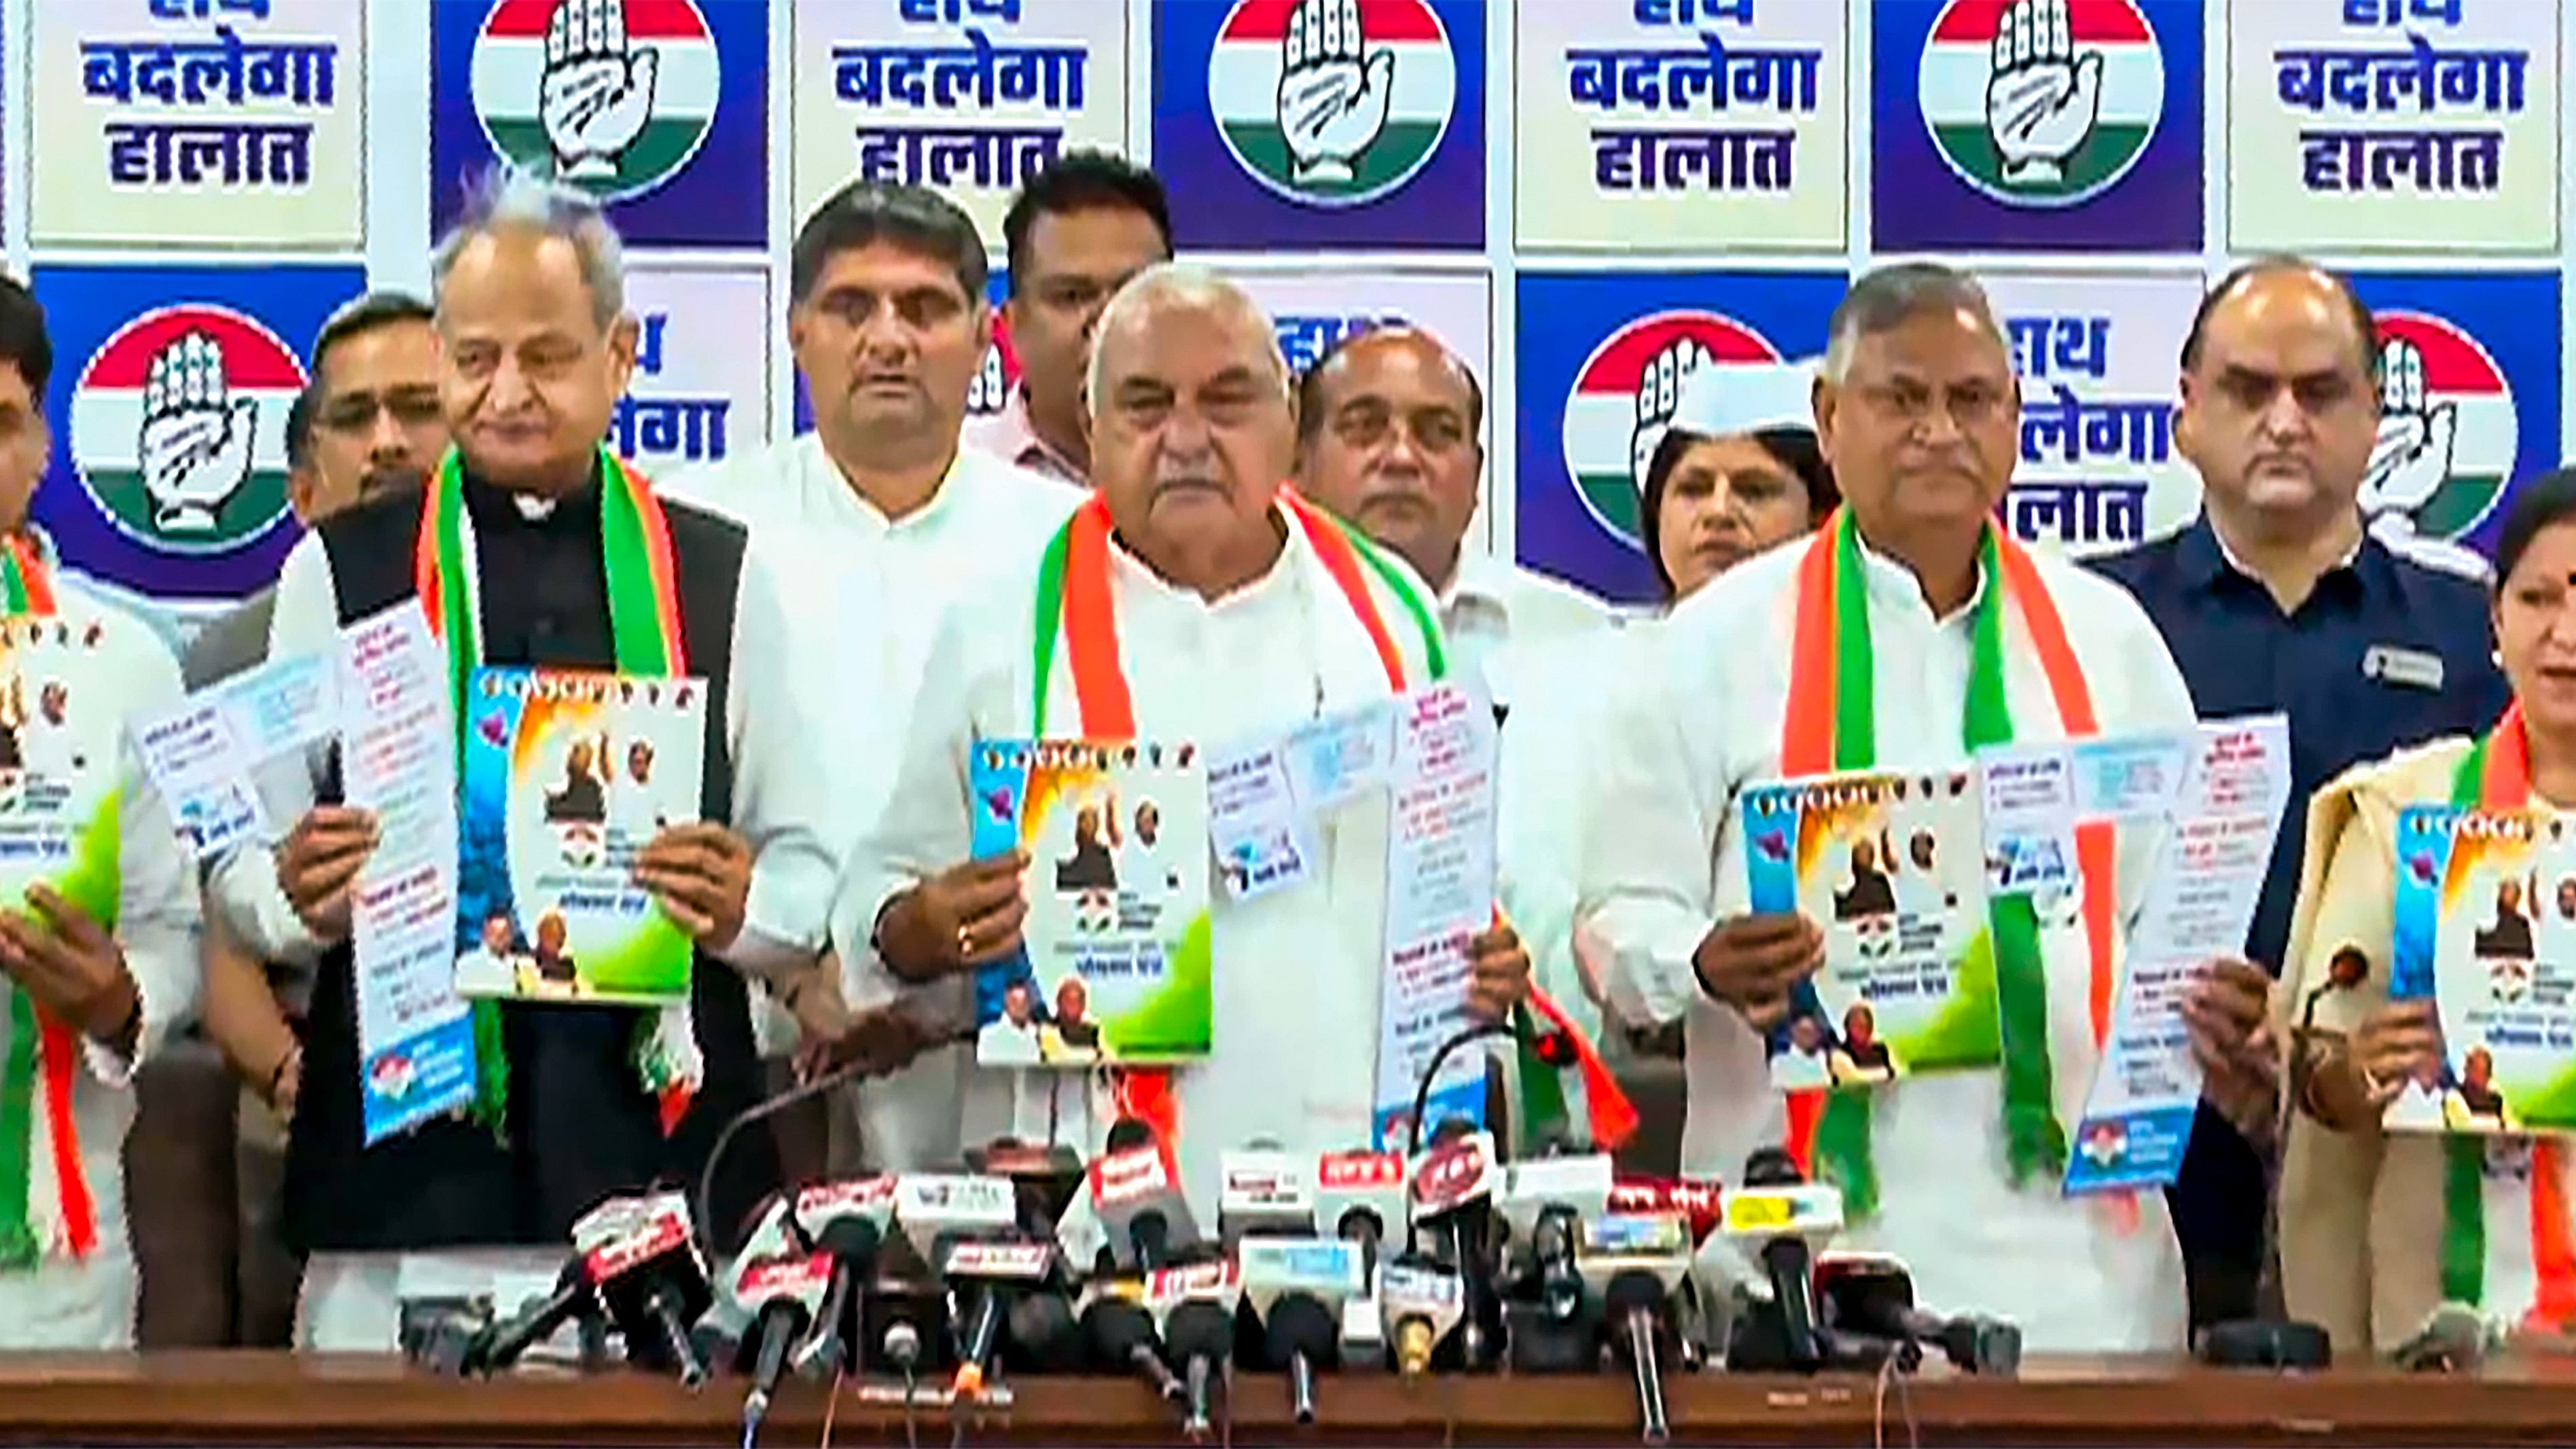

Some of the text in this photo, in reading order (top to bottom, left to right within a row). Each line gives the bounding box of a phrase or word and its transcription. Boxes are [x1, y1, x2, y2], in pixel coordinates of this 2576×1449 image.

[79, 24, 337, 105] बदलेगा
[831, 29, 1088, 108] बदलेगा
[1566, 31, 1823, 111] बदलेगा
[2274, 30, 2530, 111] बदलेगा
[105, 123, 314, 183] हालात
[1590, 128, 1795, 190] हालात
[2300, 130, 2504, 190] हालात
